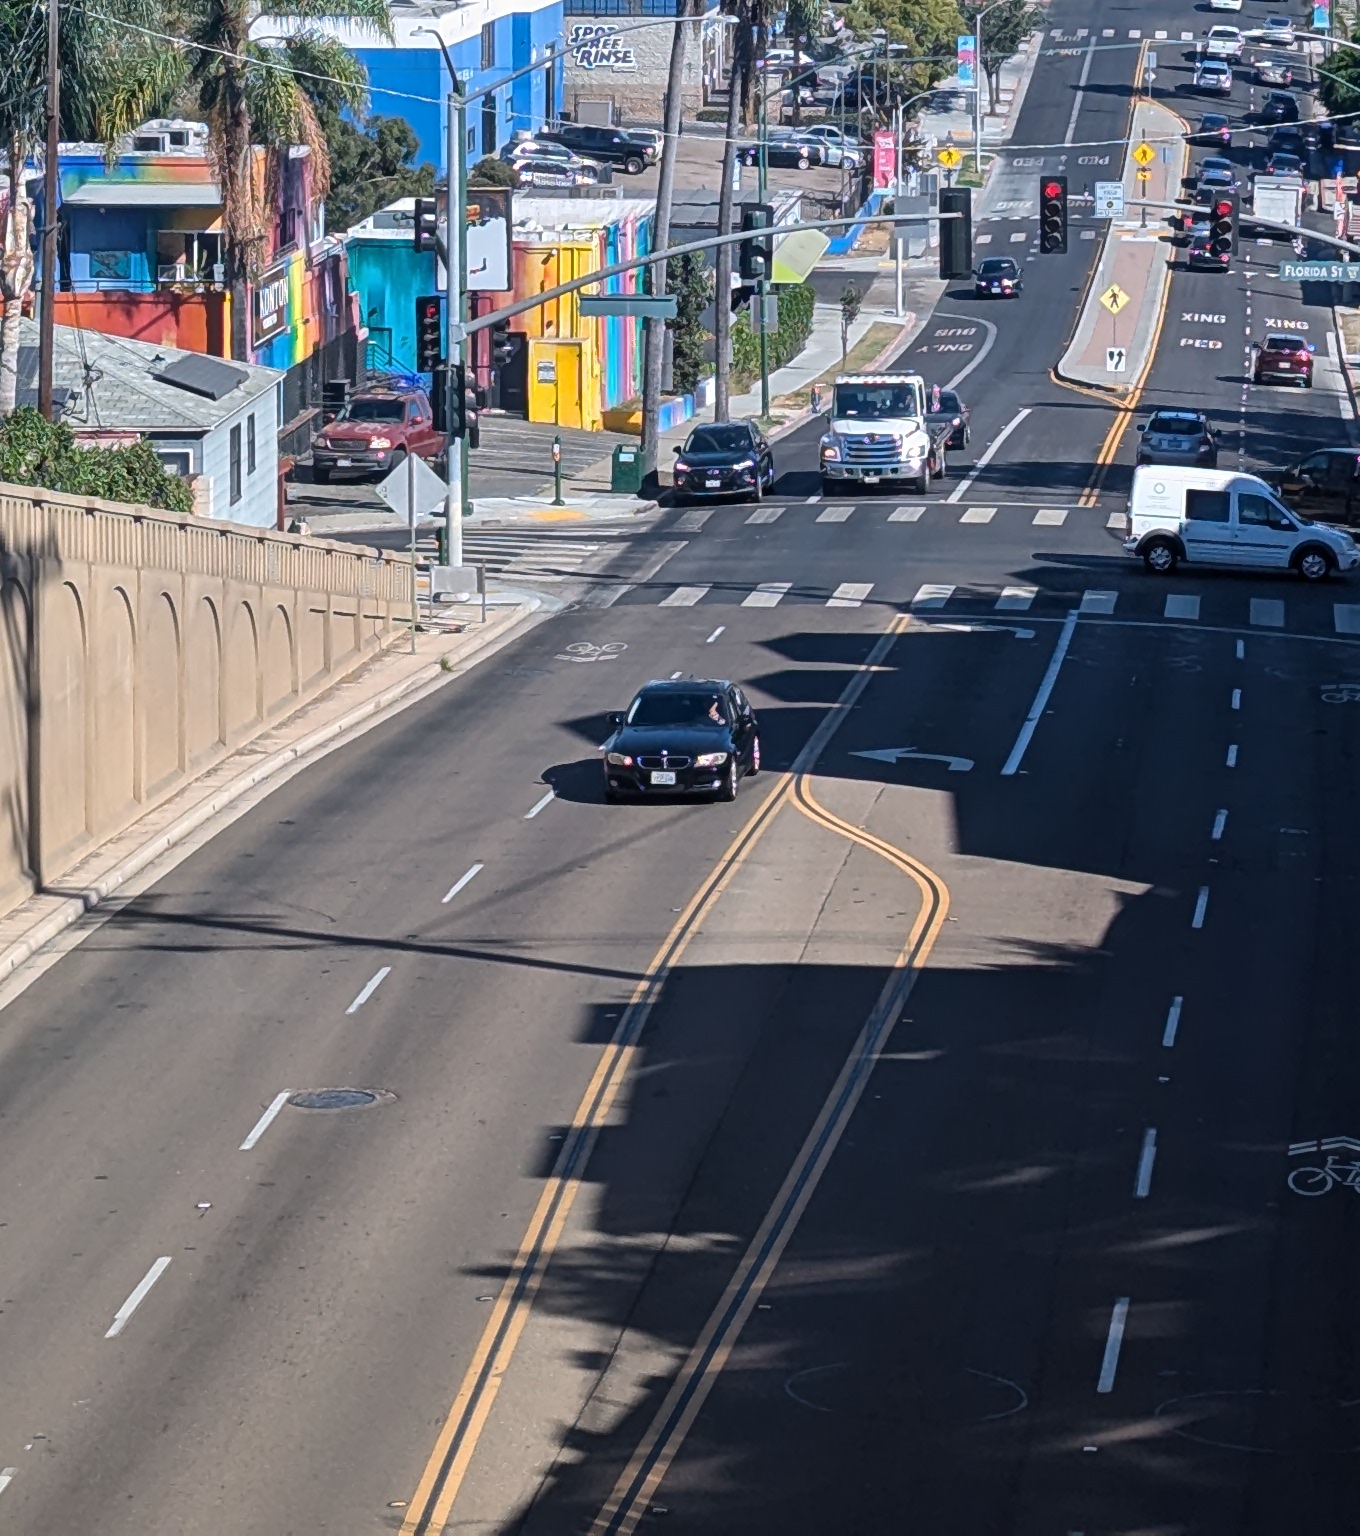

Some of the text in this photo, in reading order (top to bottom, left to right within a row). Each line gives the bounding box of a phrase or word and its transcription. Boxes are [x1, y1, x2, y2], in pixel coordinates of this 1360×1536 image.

[577, 49, 635, 68] RINSE
[1284, 264, 1328, 277] FLORIDA
[1181, 312, 1227, 324] XING
[1264, 317, 1309, 330] XING
[1179, 337, 1223, 349] PED
